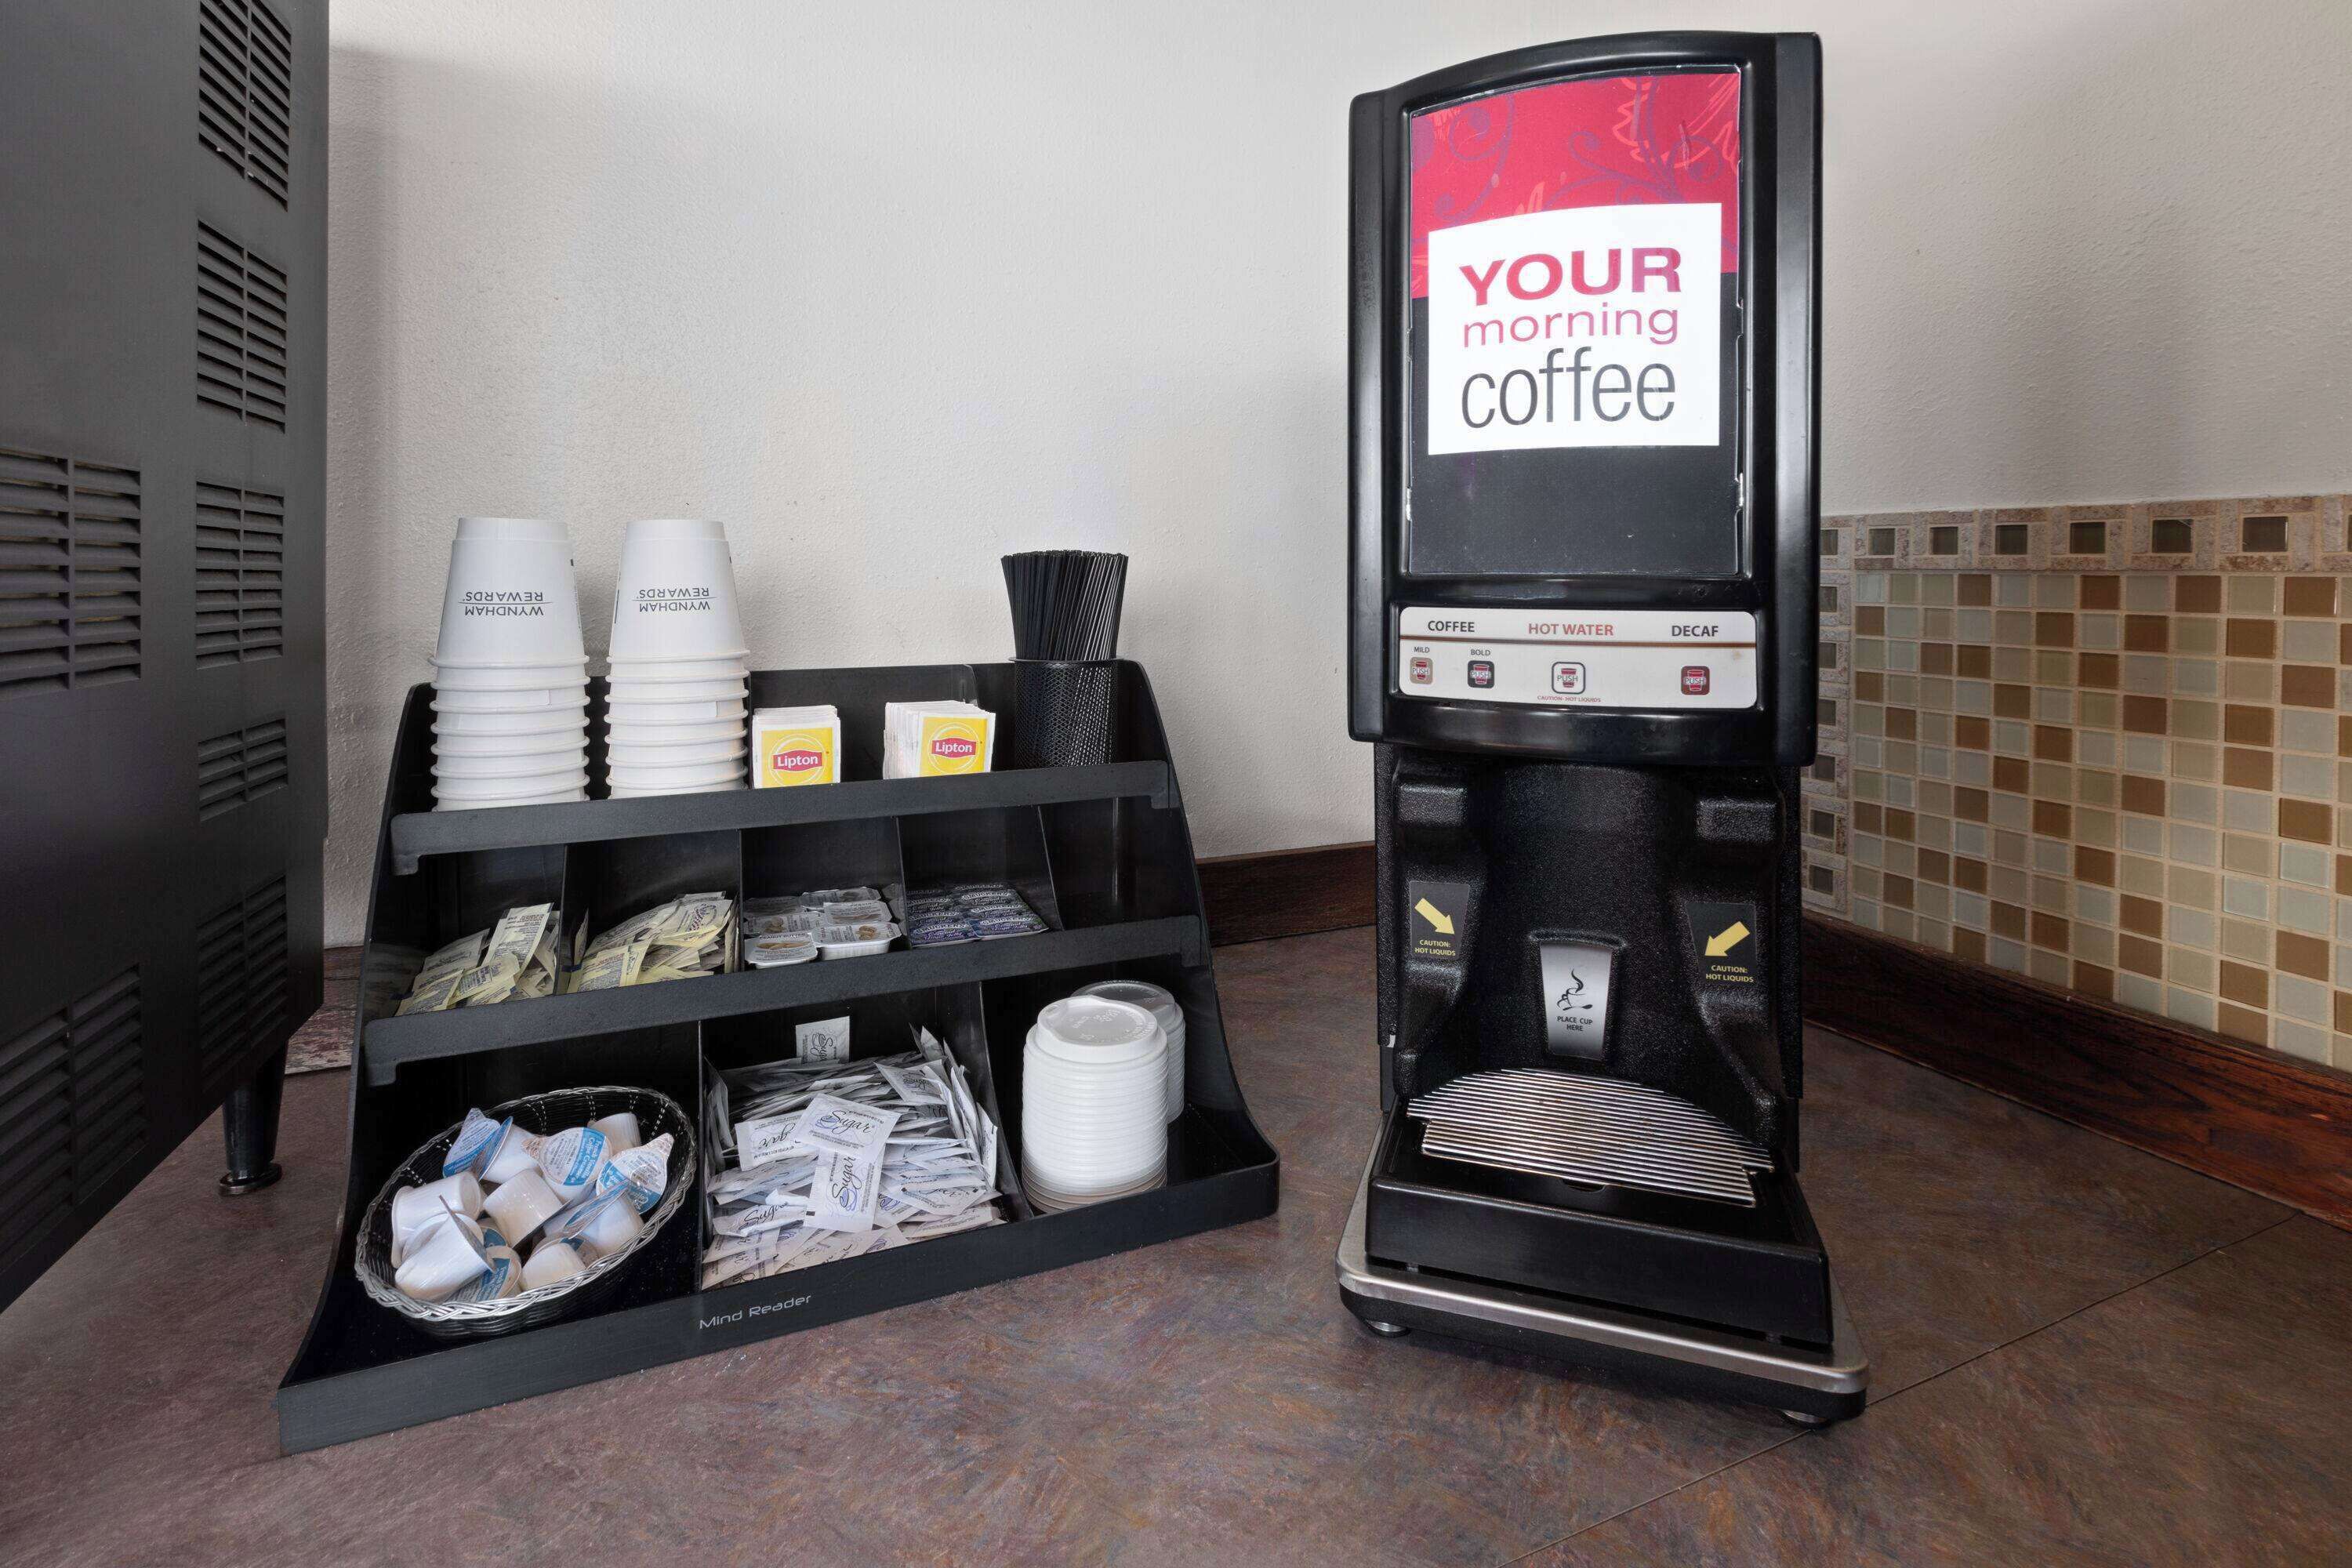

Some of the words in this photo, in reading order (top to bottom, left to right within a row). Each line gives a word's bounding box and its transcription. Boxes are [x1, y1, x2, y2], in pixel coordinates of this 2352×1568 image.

[1459, 247, 1682, 307] YOUR
[1464, 302, 1679, 348] morning
[1461, 346, 1676, 429] coffee
[465, 591, 543, 602] REWARDS
[639, 587, 710, 599] REWARDS
[465, 605, 544, 616] WYNDHAM
[639, 601, 710, 612] WYNDHAM
[1427, 620, 1475, 633] COFFEE
[1528, 623, 1559, 635] HOT
[1562, 624, 1614, 636] WATER
[1671, 625, 1719, 637] DECAF
[1469, 670, 1492, 679] PUSH
[935, 742, 973, 755] Lipton
[777, 755, 818, 769] Lipton
[1419, 939, 1452, 948] CAUTION:
[1722, 975, 1754, 983] LIQUIDS
[821, 1110, 872, 1134] Sugar
[831, 1156, 862, 1208] Sugar
[699, 1310, 743, 1330] Mind
[749, 1294, 812, 1318] Reader
